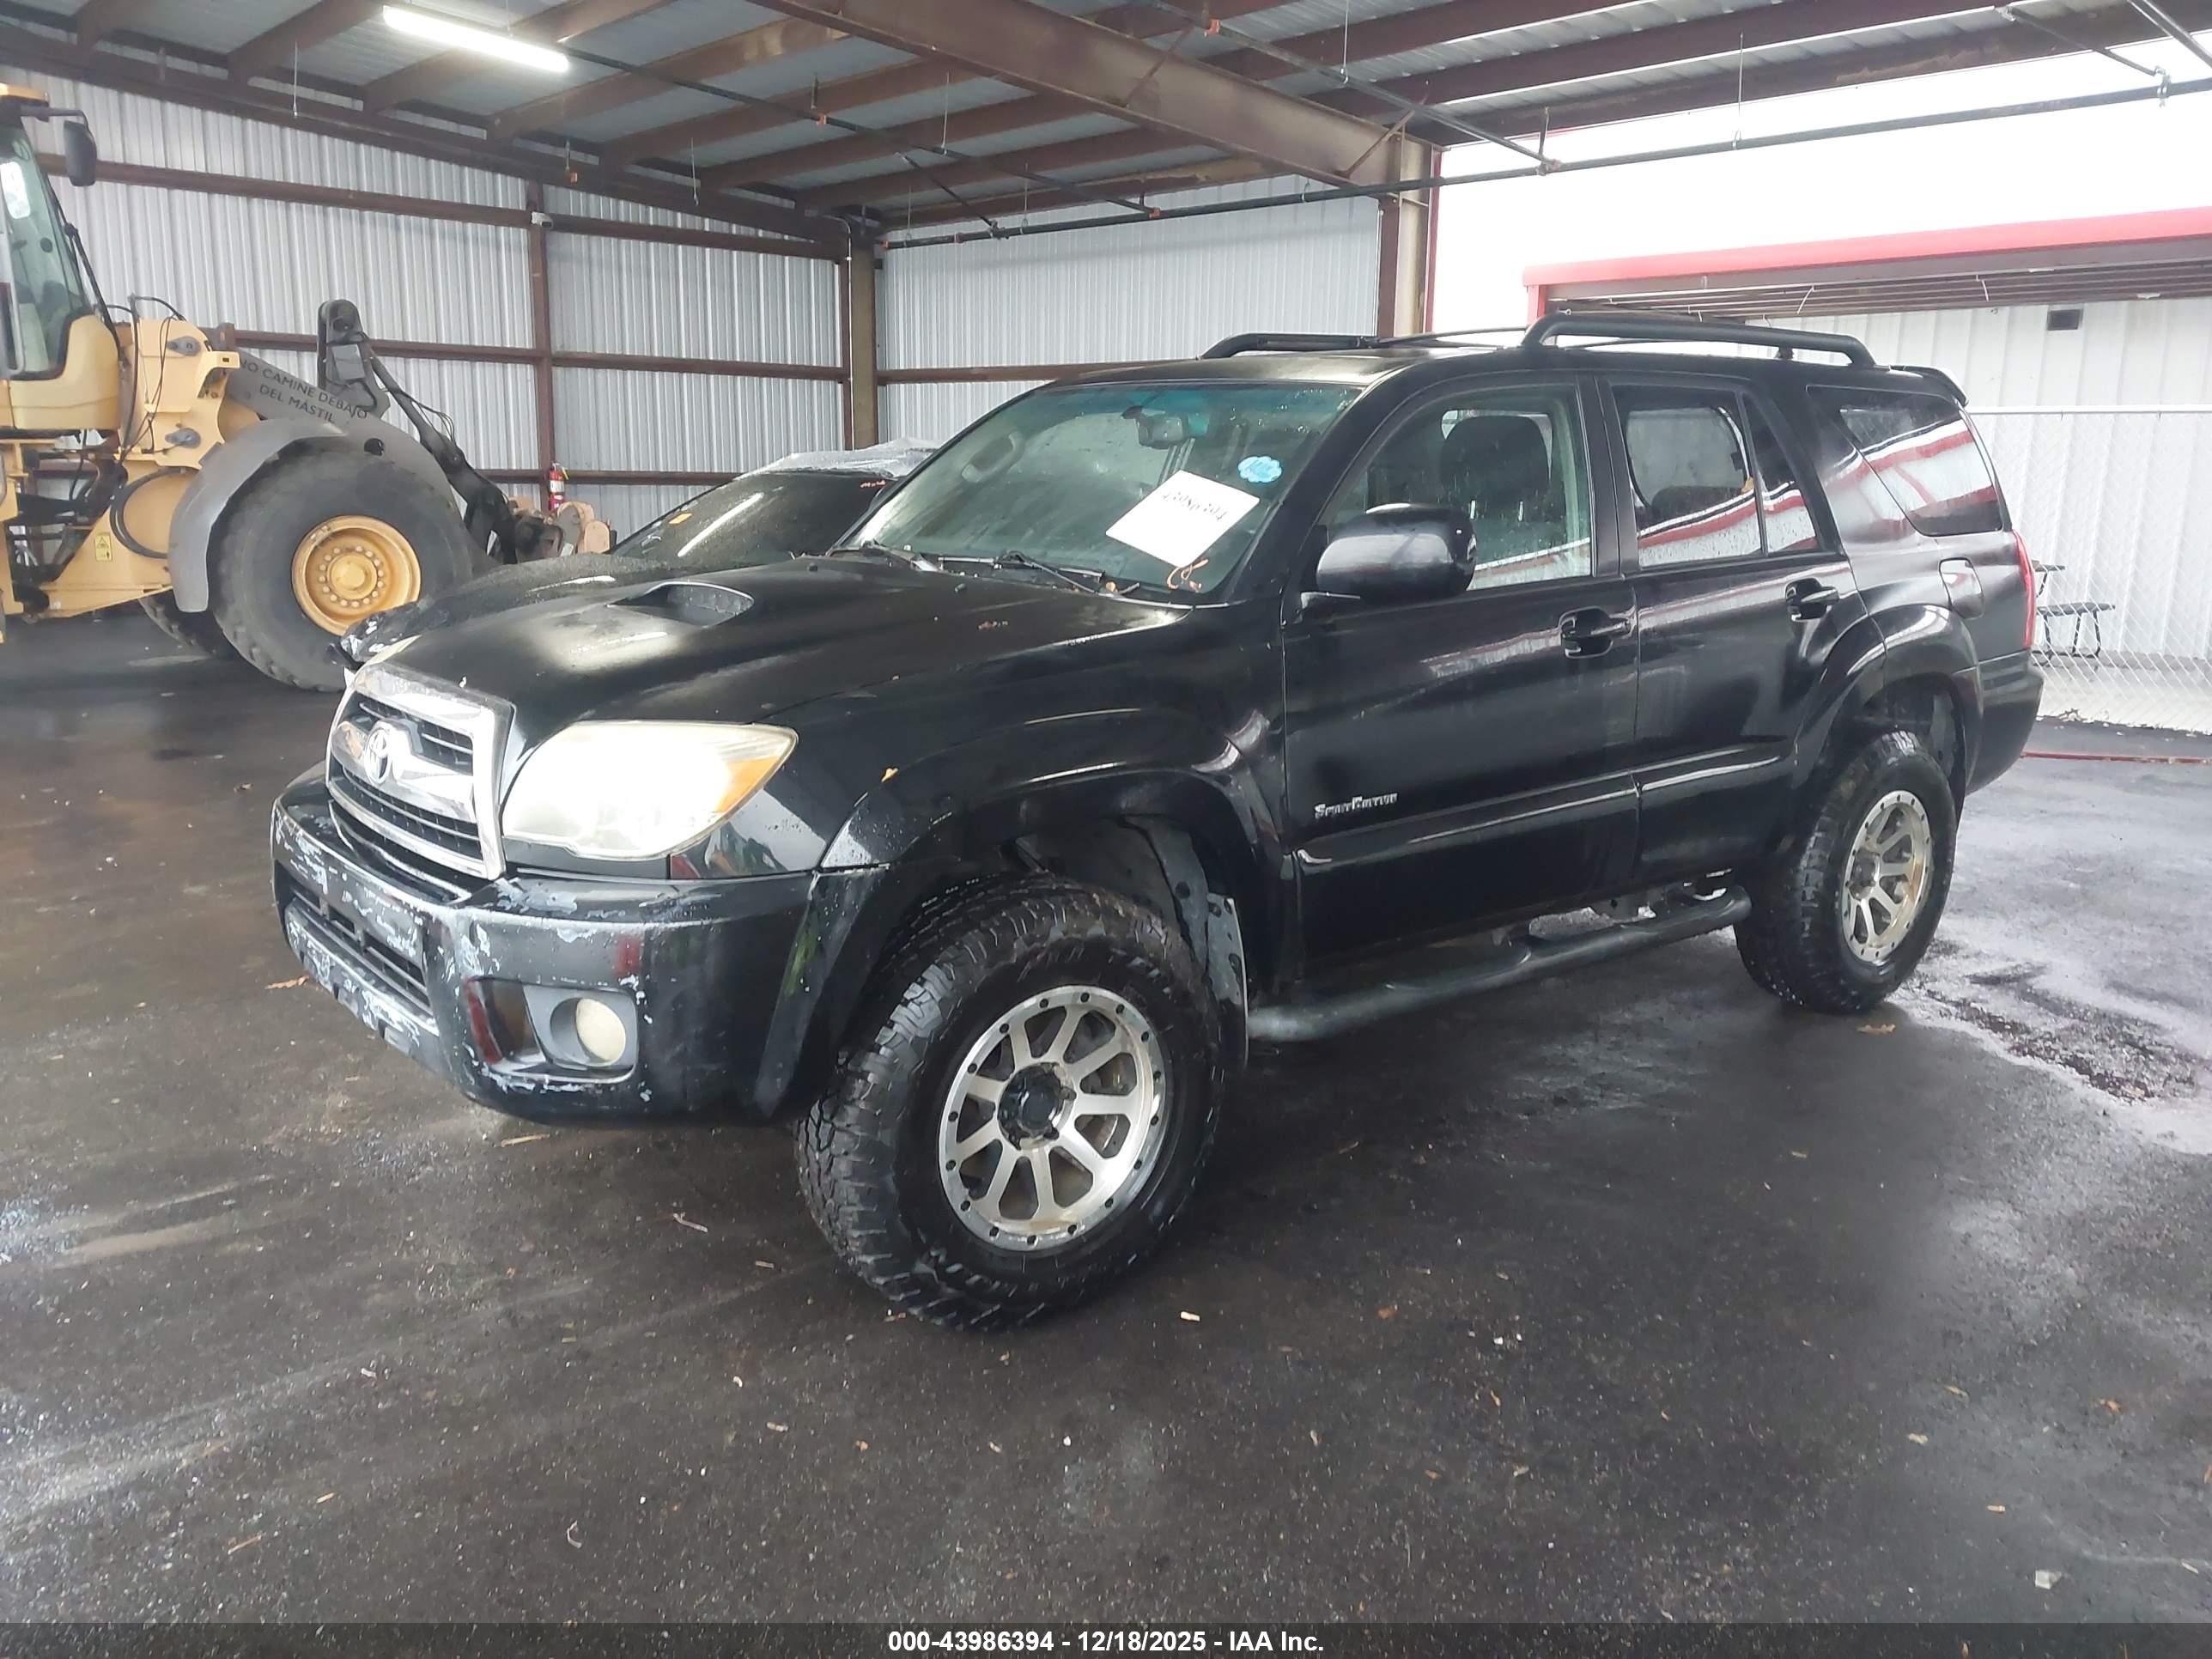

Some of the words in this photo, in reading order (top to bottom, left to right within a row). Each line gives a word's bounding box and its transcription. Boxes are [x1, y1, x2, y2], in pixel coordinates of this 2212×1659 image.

[259, 385, 283, 403] DEL
[262, 368, 315, 398] CAMINE
[319, 392, 368, 419] DEBAJO
